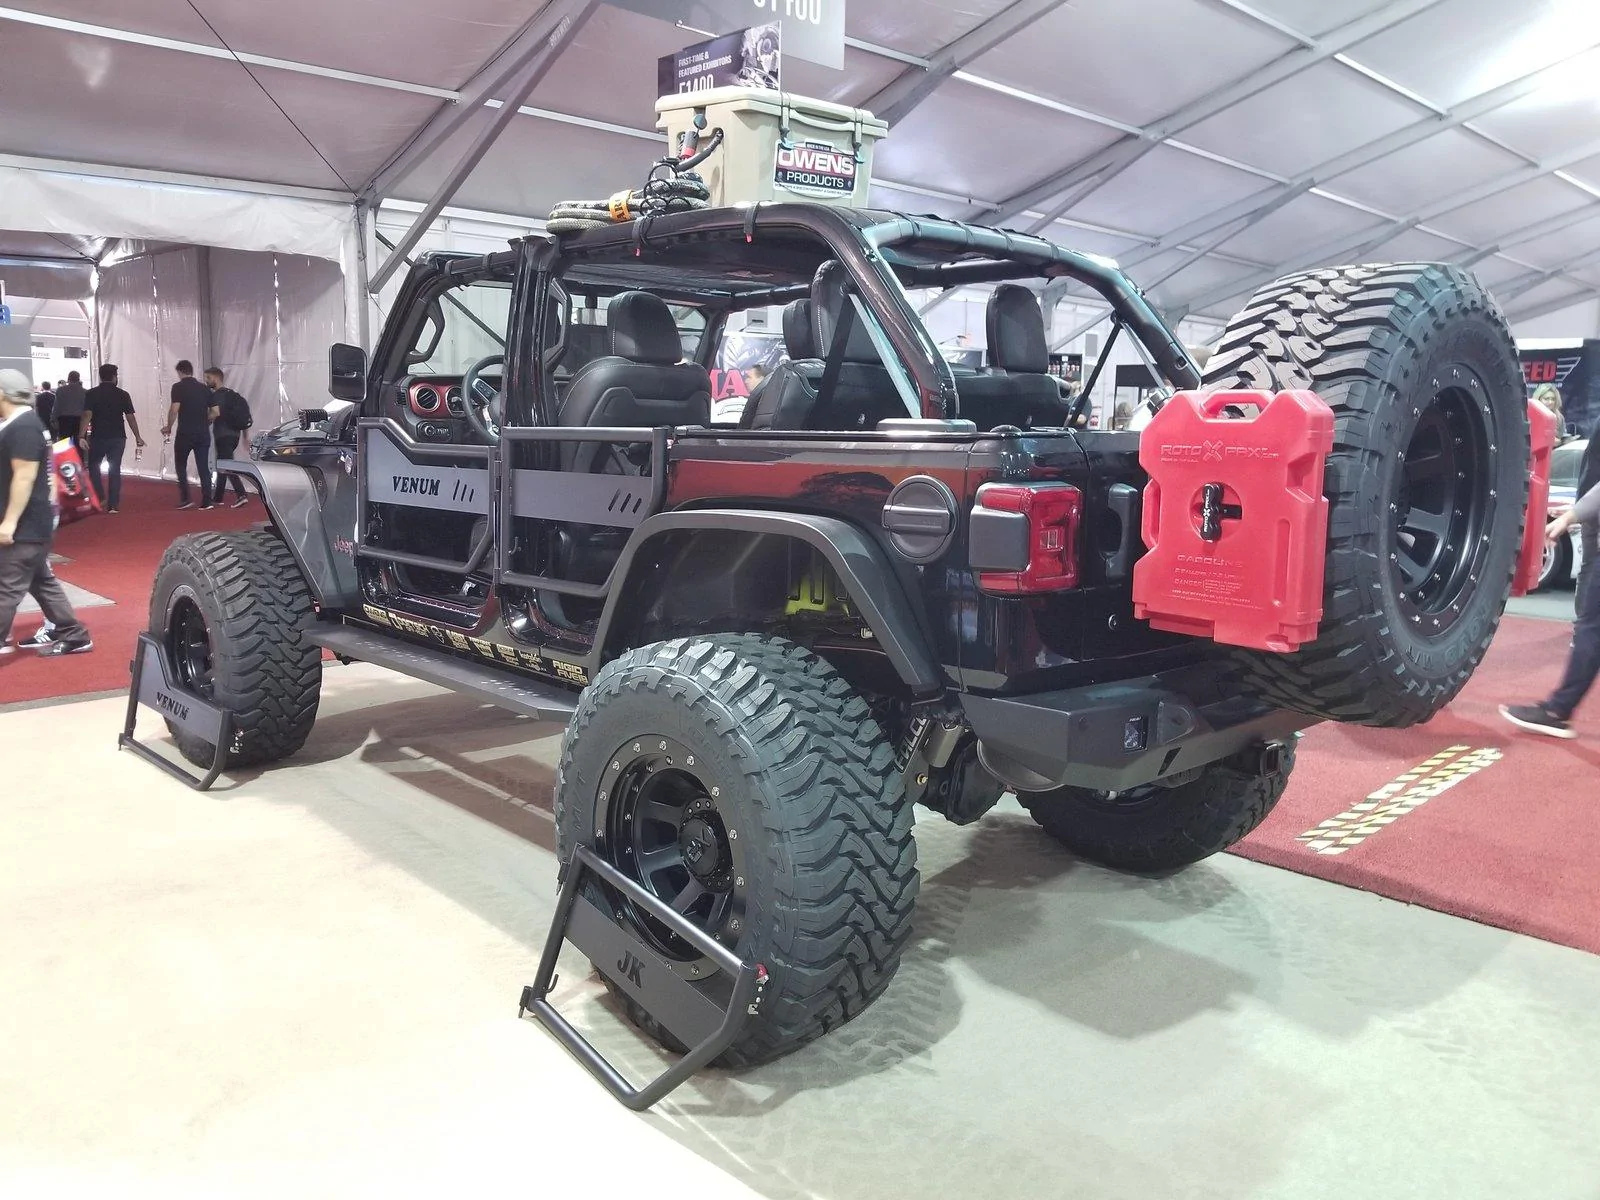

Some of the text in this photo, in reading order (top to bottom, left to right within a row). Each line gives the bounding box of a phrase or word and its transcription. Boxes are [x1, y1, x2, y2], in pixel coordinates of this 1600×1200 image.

[678, 52, 704, 67] FIRST-TIME
[678, 55, 733, 78] FEATURED EXHIBITORS
[777, 149, 855, 176] OWENS
[786, 172, 845, 188] PRODUCTS
[1160, 445, 1202, 456] ROTO
[392, 476, 441, 496] VENUM
[552, 659, 583, 675] RIGID
[156, 691, 190, 721] VENUM
[617, 950, 646, 987] JK
